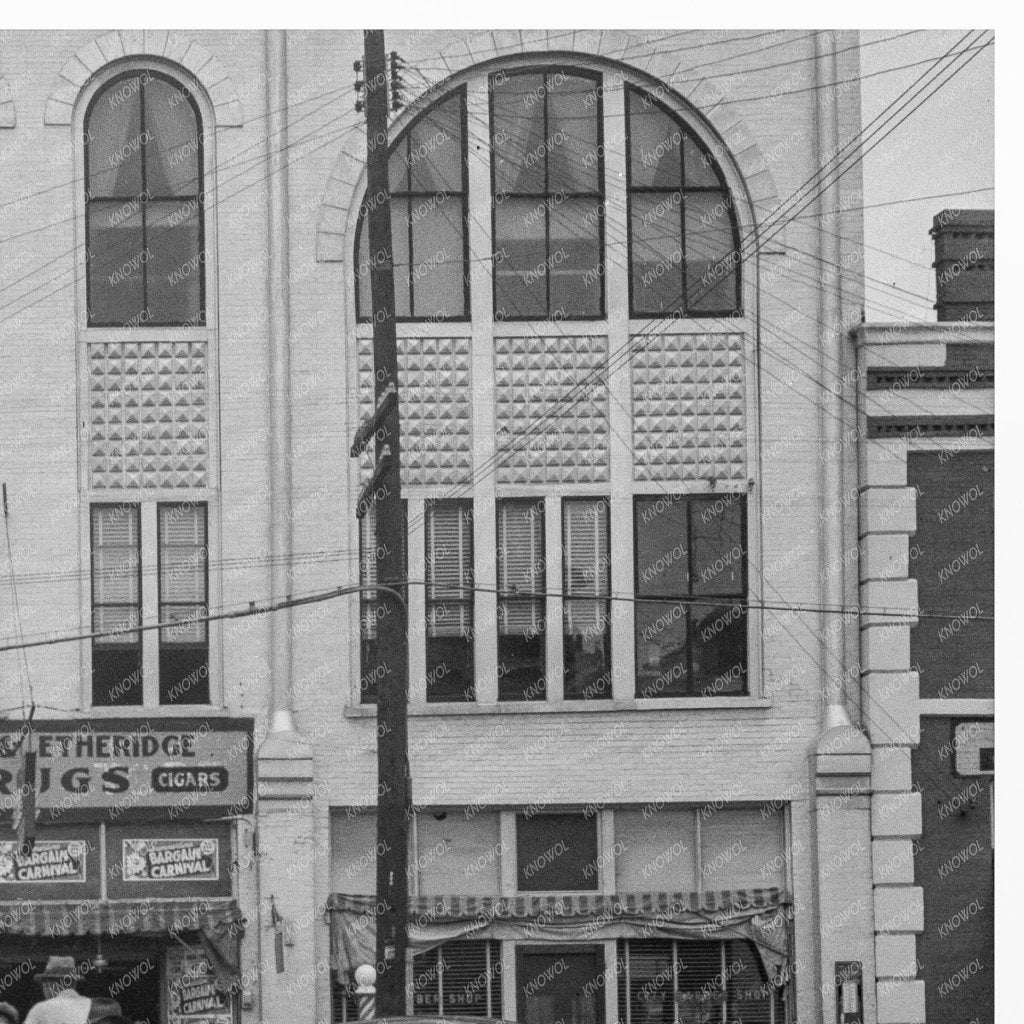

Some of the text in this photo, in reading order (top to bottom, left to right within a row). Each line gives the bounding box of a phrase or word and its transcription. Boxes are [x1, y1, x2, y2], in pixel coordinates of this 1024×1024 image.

[39, 734, 196, 757] ETHERIDGE
[158, 772, 222, 788] CIGARS
[148, 847, 202, 866] BARGAIN
[18, 861, 78, 880] CARNIVAL
[151, 860, 211, 878] CARNIVAL
